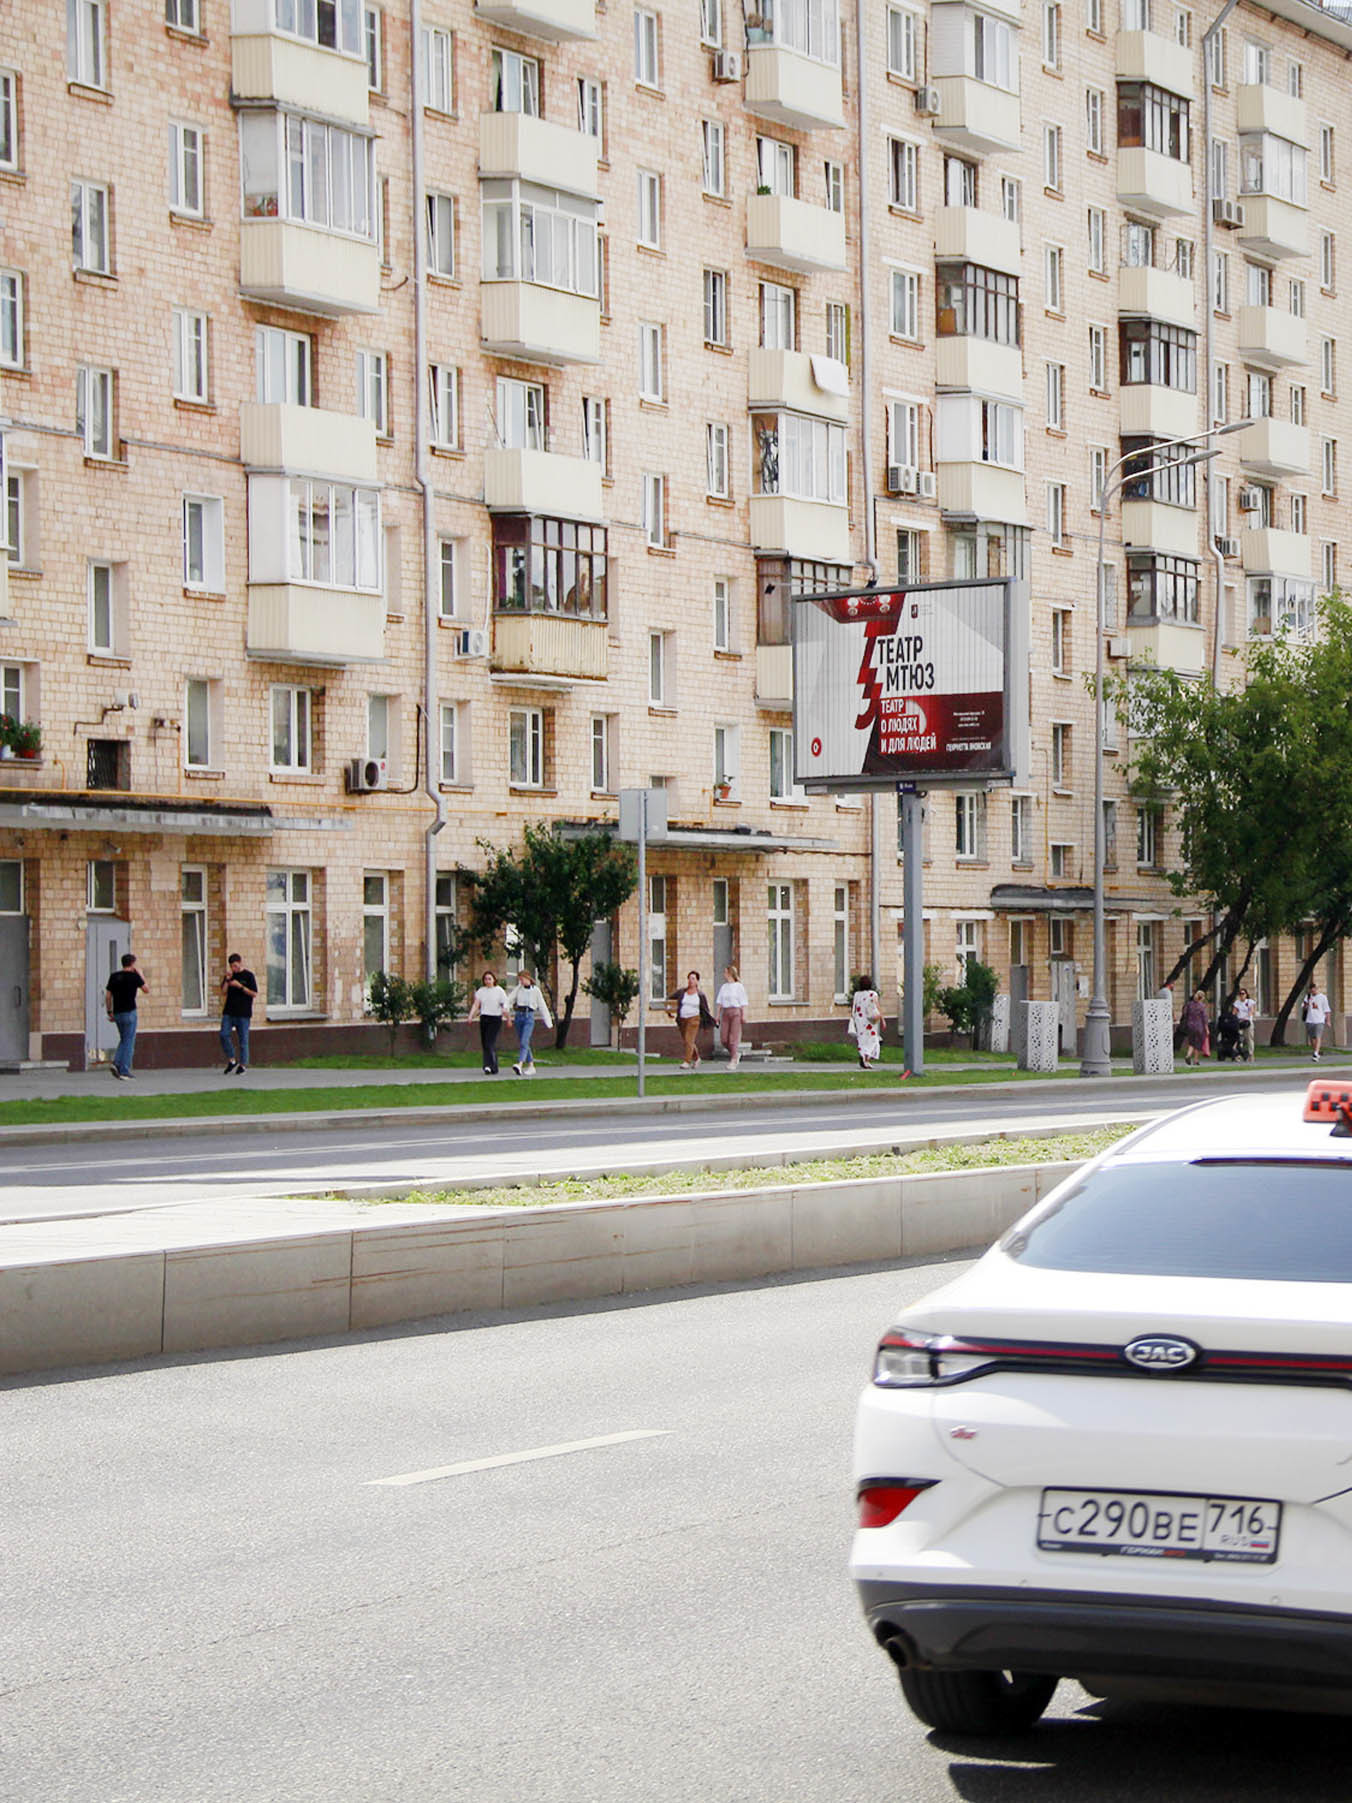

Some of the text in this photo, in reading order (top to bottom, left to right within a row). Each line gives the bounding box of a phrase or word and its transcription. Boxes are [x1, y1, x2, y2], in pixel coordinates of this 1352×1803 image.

[878, 636, 923, 665] ТЕАТР
[887, 662, 935, 692] МТЮЗ
[881, 699, 904, 714] ТЕАТР
[881, 717, 918, 734] О ЛЮДЯХ
[881, 732, 937, 754] И ДЛЯ ЛЮДЕЙ
[1135, 1345, 1185, 1361] JAC
[1053, 1498, 1264, 1542] С290ВЕ 716
[1221, 1534, 1249, 1547] RUS
